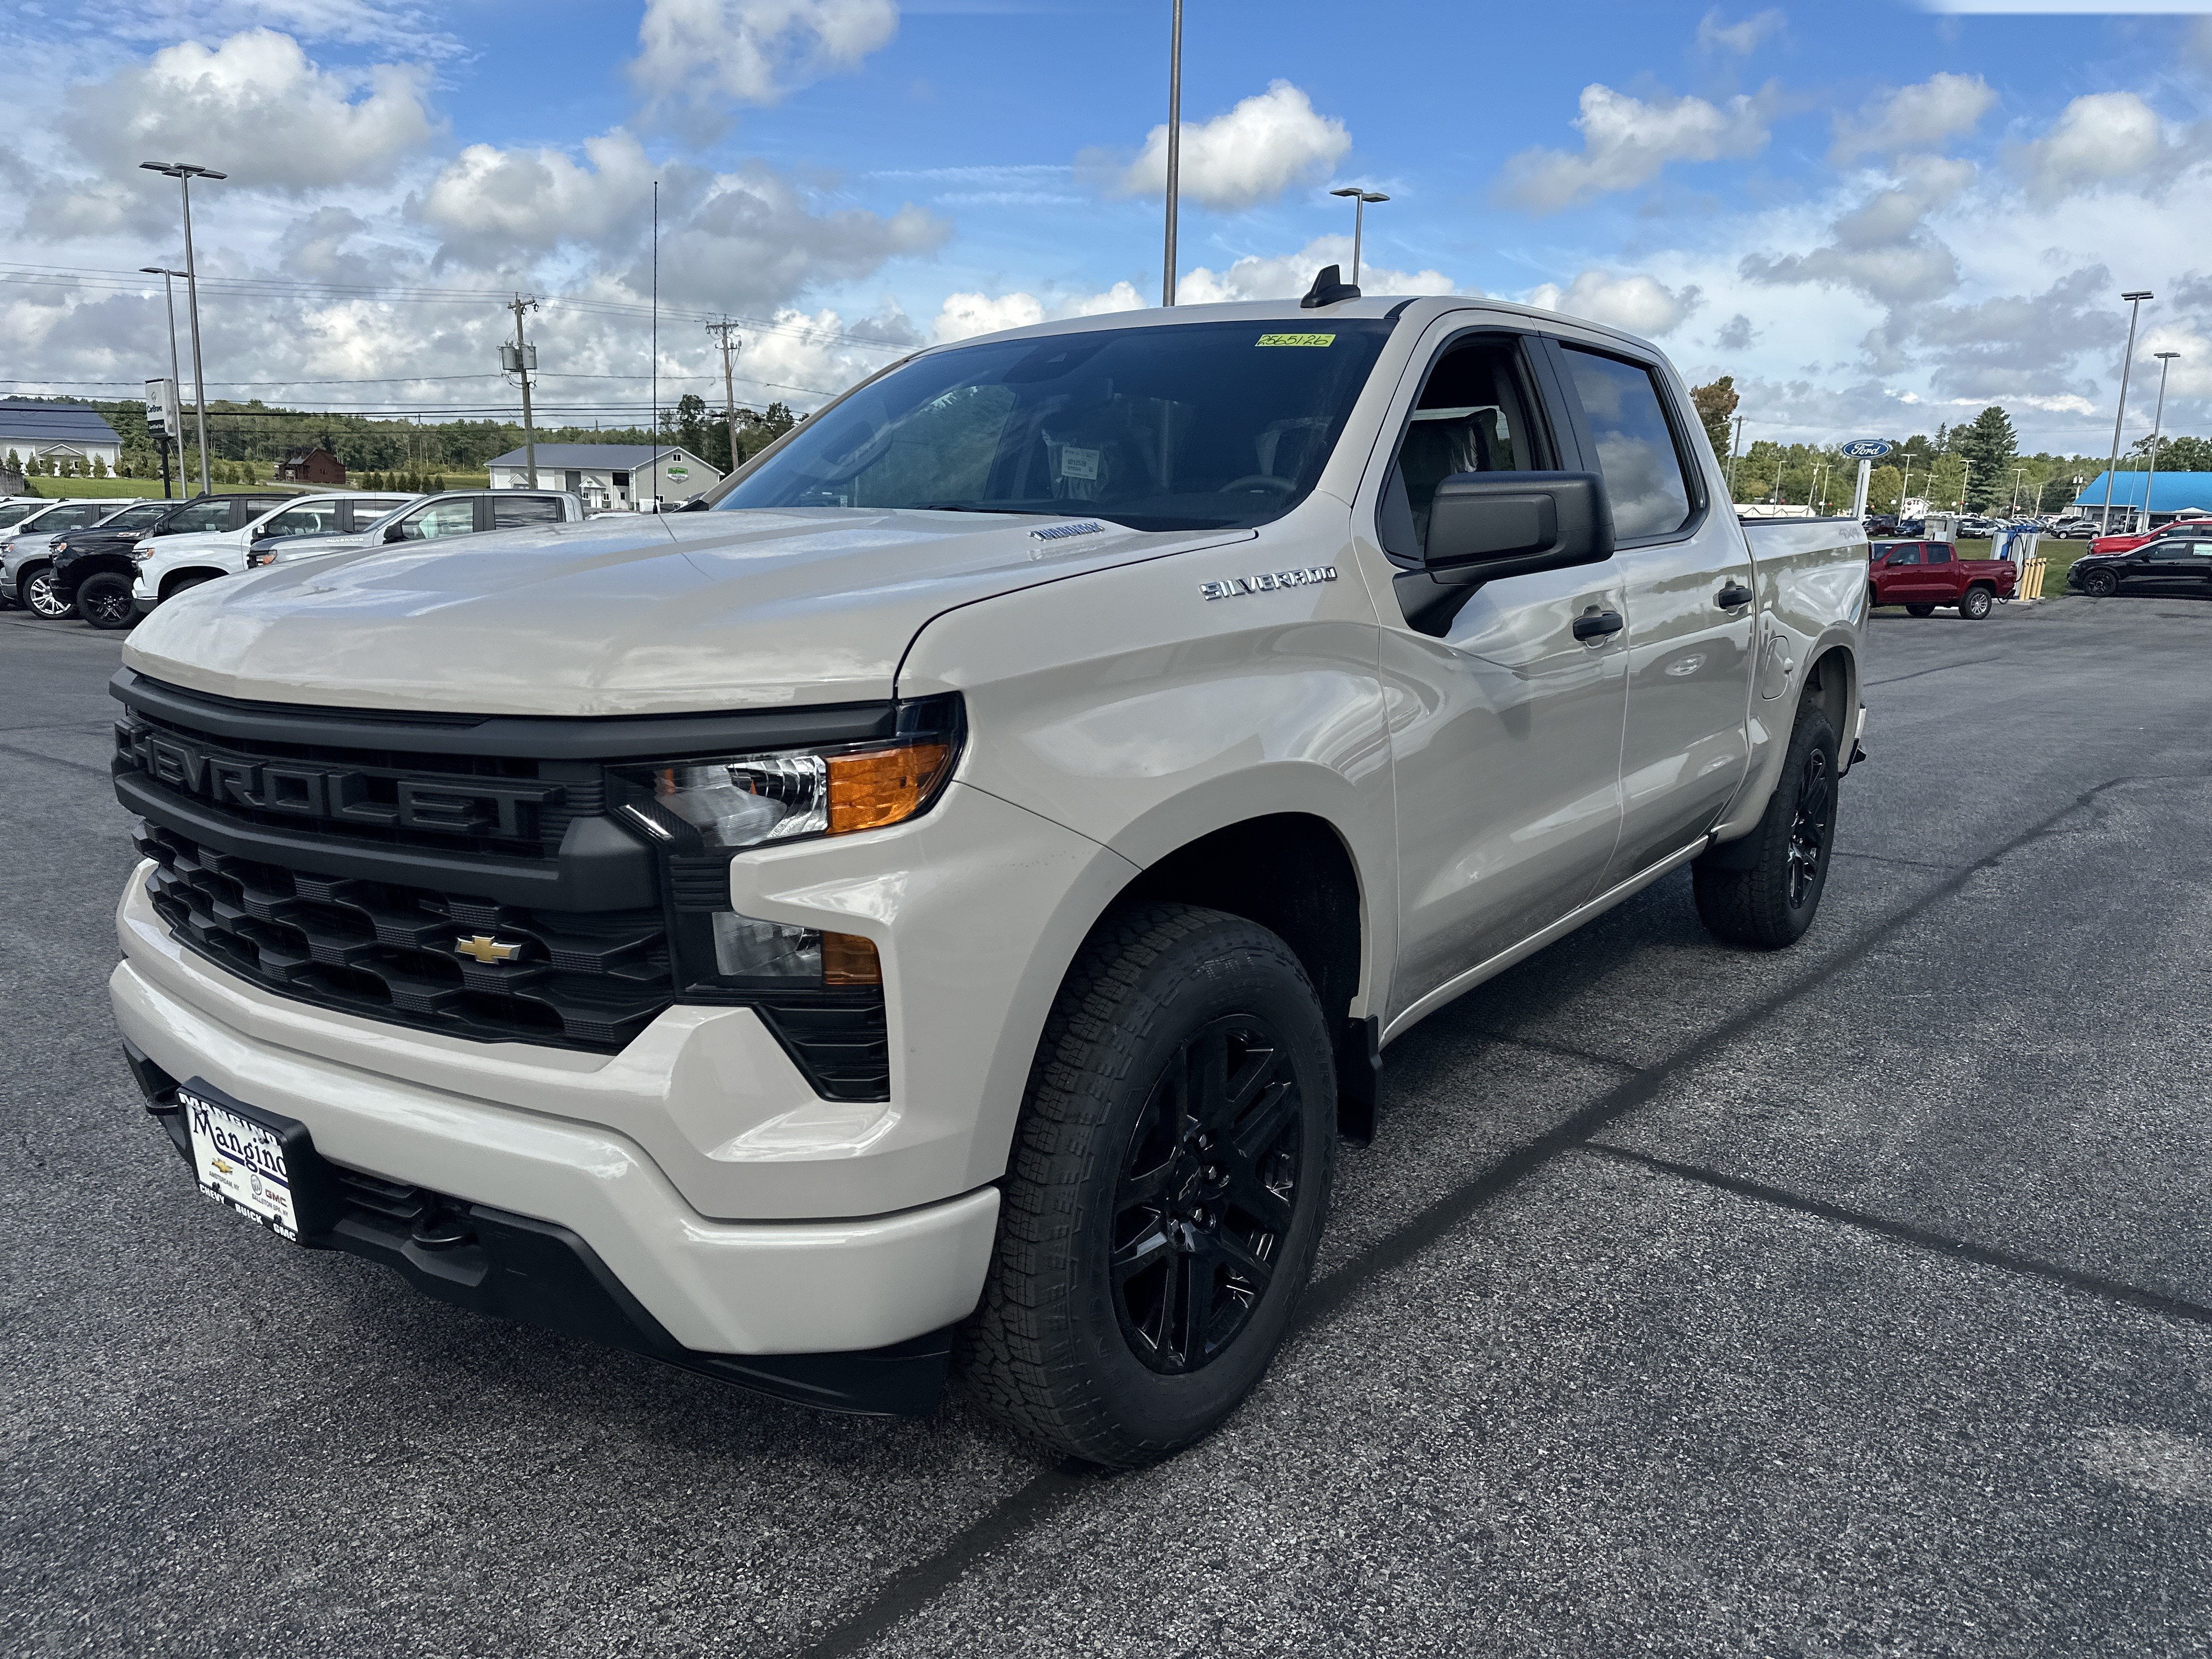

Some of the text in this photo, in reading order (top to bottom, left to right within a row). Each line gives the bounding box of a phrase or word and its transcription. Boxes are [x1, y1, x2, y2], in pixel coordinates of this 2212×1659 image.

[1851, 443, 1881, 455] Ford
[1199, 566, 1338, 601] SILVERADO
[114, 718, 567, 837] CHEVROLET
[178, 1092, 278, 1146] MANGINO
[194, 1109, 287, 1177] Mangino
[199, 1183, 296, 1242] CHEVY BUICK GMC
[265, 1188, 287, 1208] GMC
